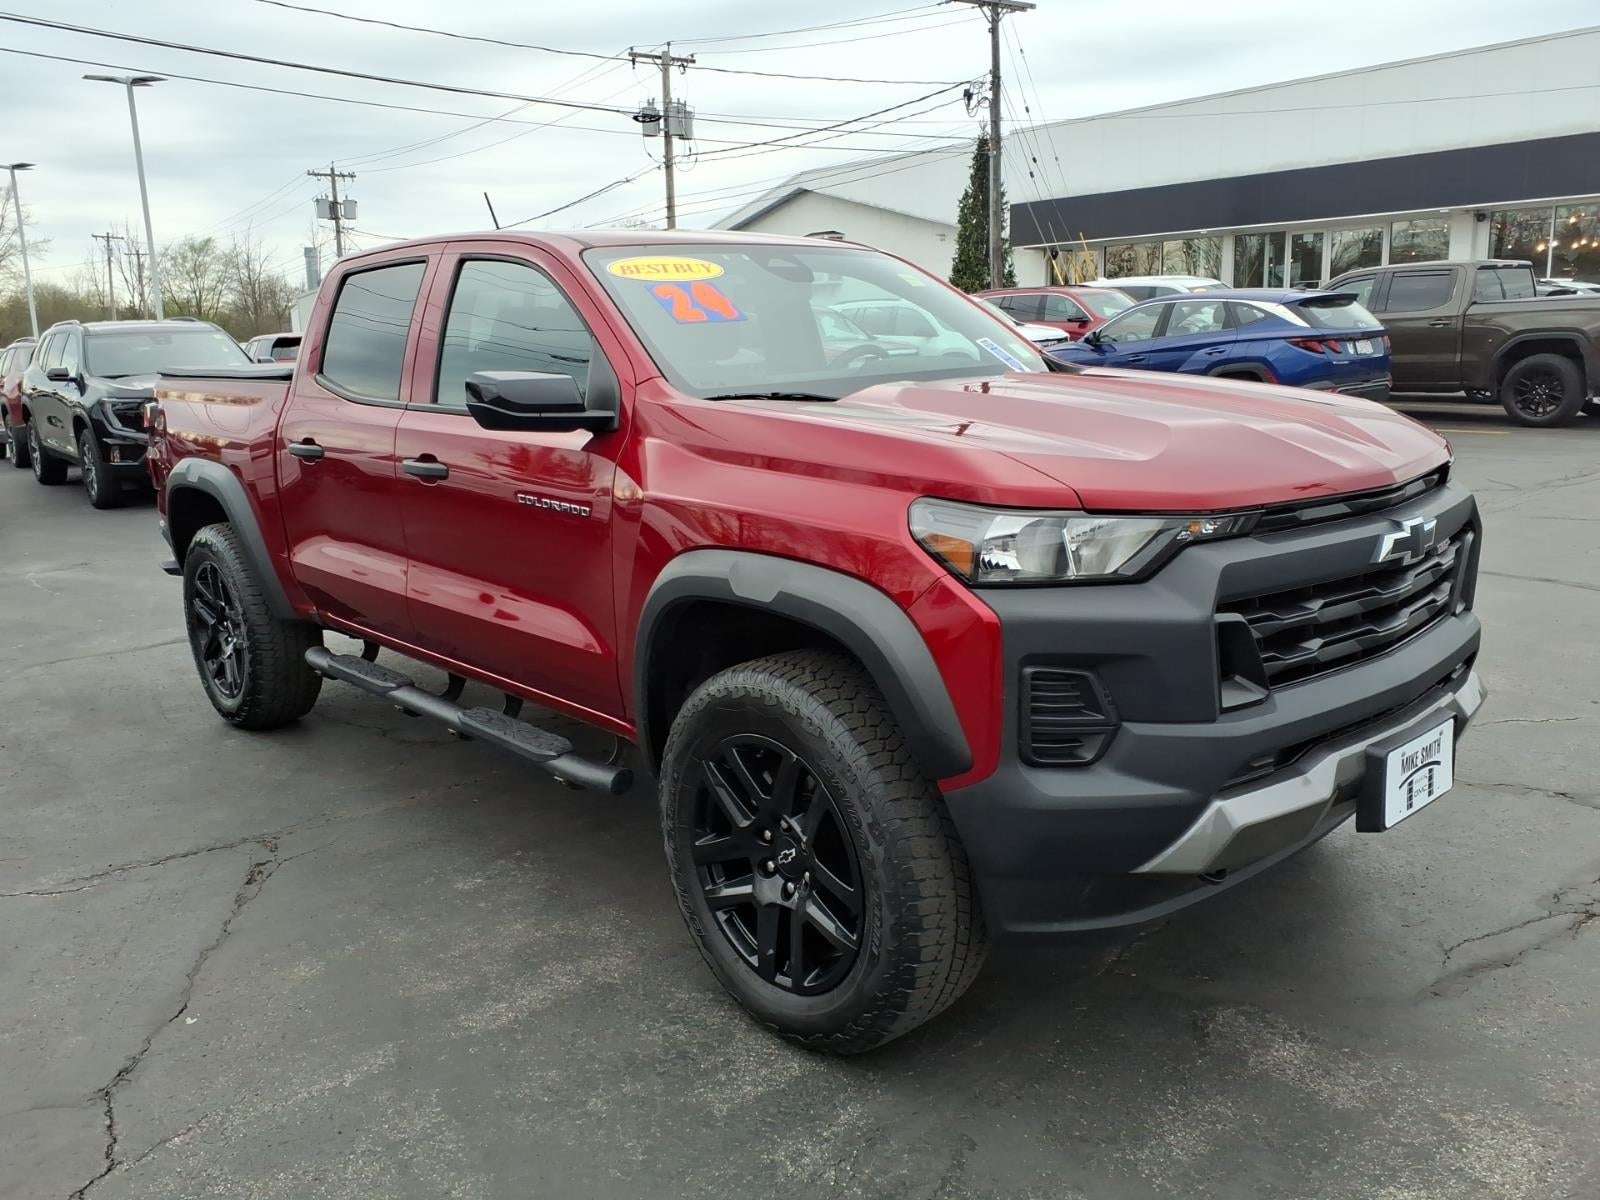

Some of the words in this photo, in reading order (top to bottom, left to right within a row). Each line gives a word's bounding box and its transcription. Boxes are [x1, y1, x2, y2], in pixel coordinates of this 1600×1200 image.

[619, 263, 669, 275] BEST
[674, 263, 712, 274] BUY
[652, 282, 740, 322] 24
[517, 493, 591, 517] COLORADO
[1401, 750, 1420, 777] MIKE
[1420, 737, 1441, 764] SMITH
